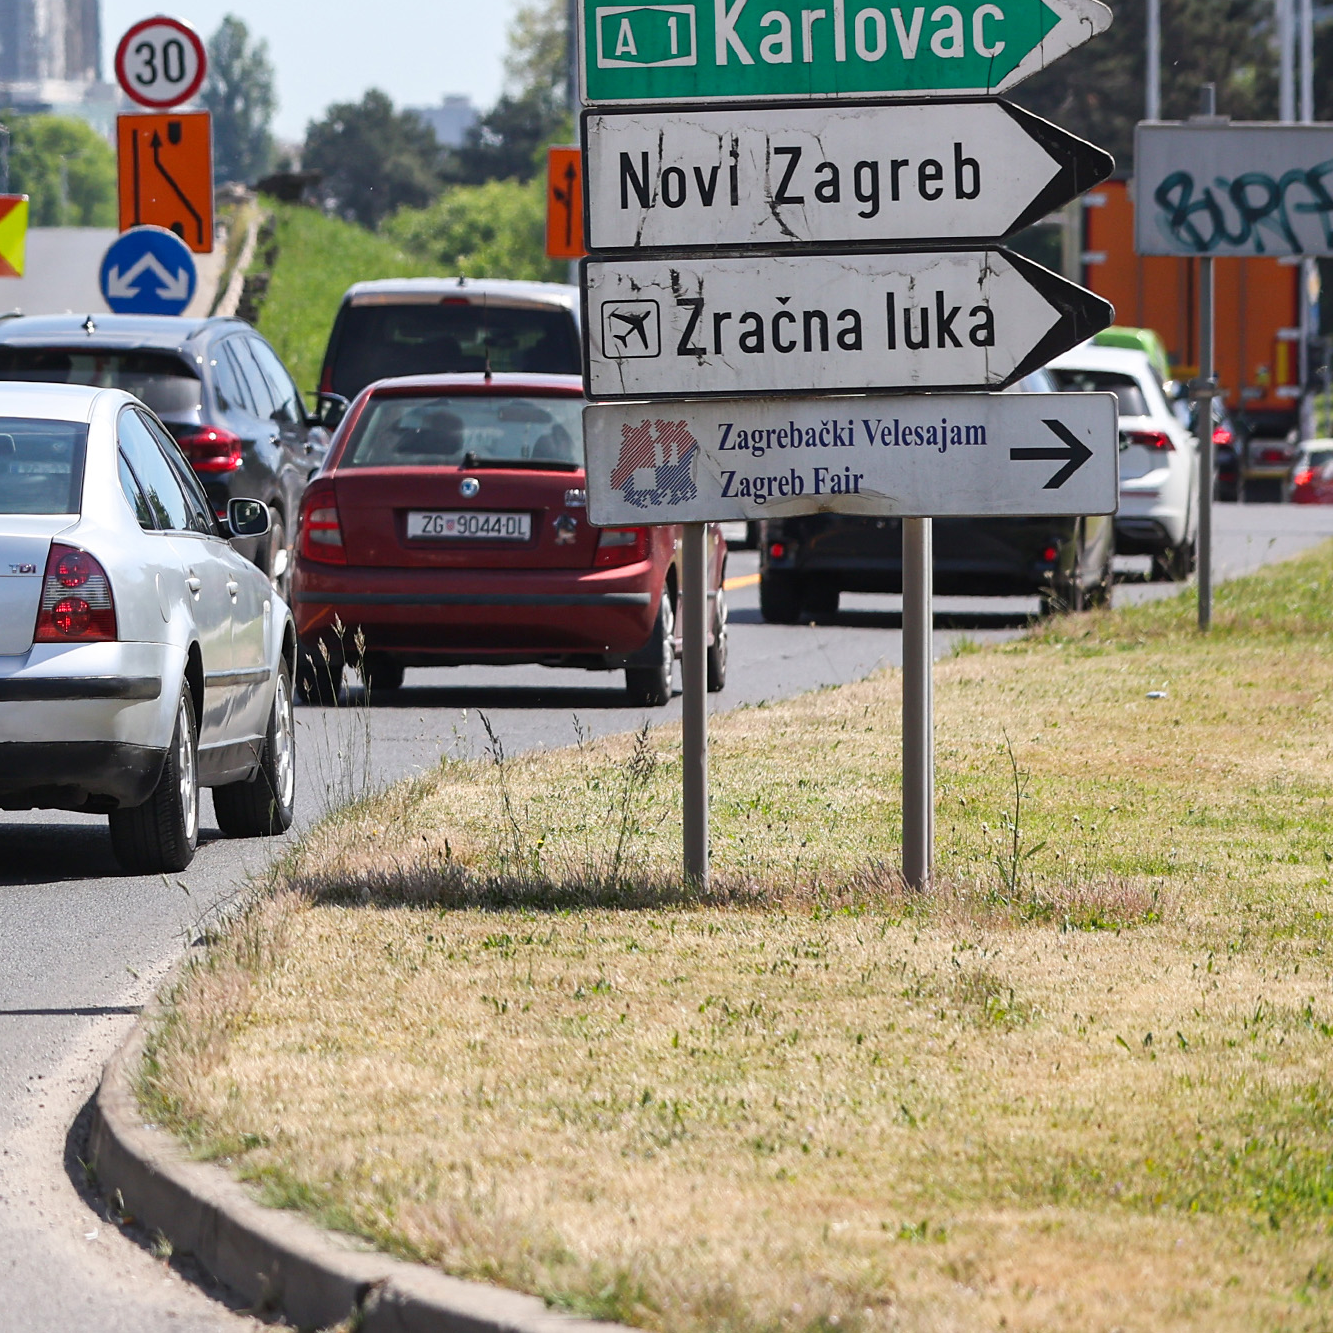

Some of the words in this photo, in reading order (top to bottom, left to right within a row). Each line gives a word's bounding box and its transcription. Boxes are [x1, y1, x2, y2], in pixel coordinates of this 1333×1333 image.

[135, 38, 186, 85] 30
[619, 150, 740, 210] Novi
[773, 142, 981, 220] Zagreb
[676, 295, 864, 357] Zračna
[885, 290, 996, 351] luka
[717, 419, 855, 457] Zagrebački
[861, 417, 988, 454] Velesajam
[720, 468, 805, 505] Zagreb
[812, 466, 864, 496] Fair
[422, 515, 444, 535] ZG
[8, 563, 37, 574] TDI
